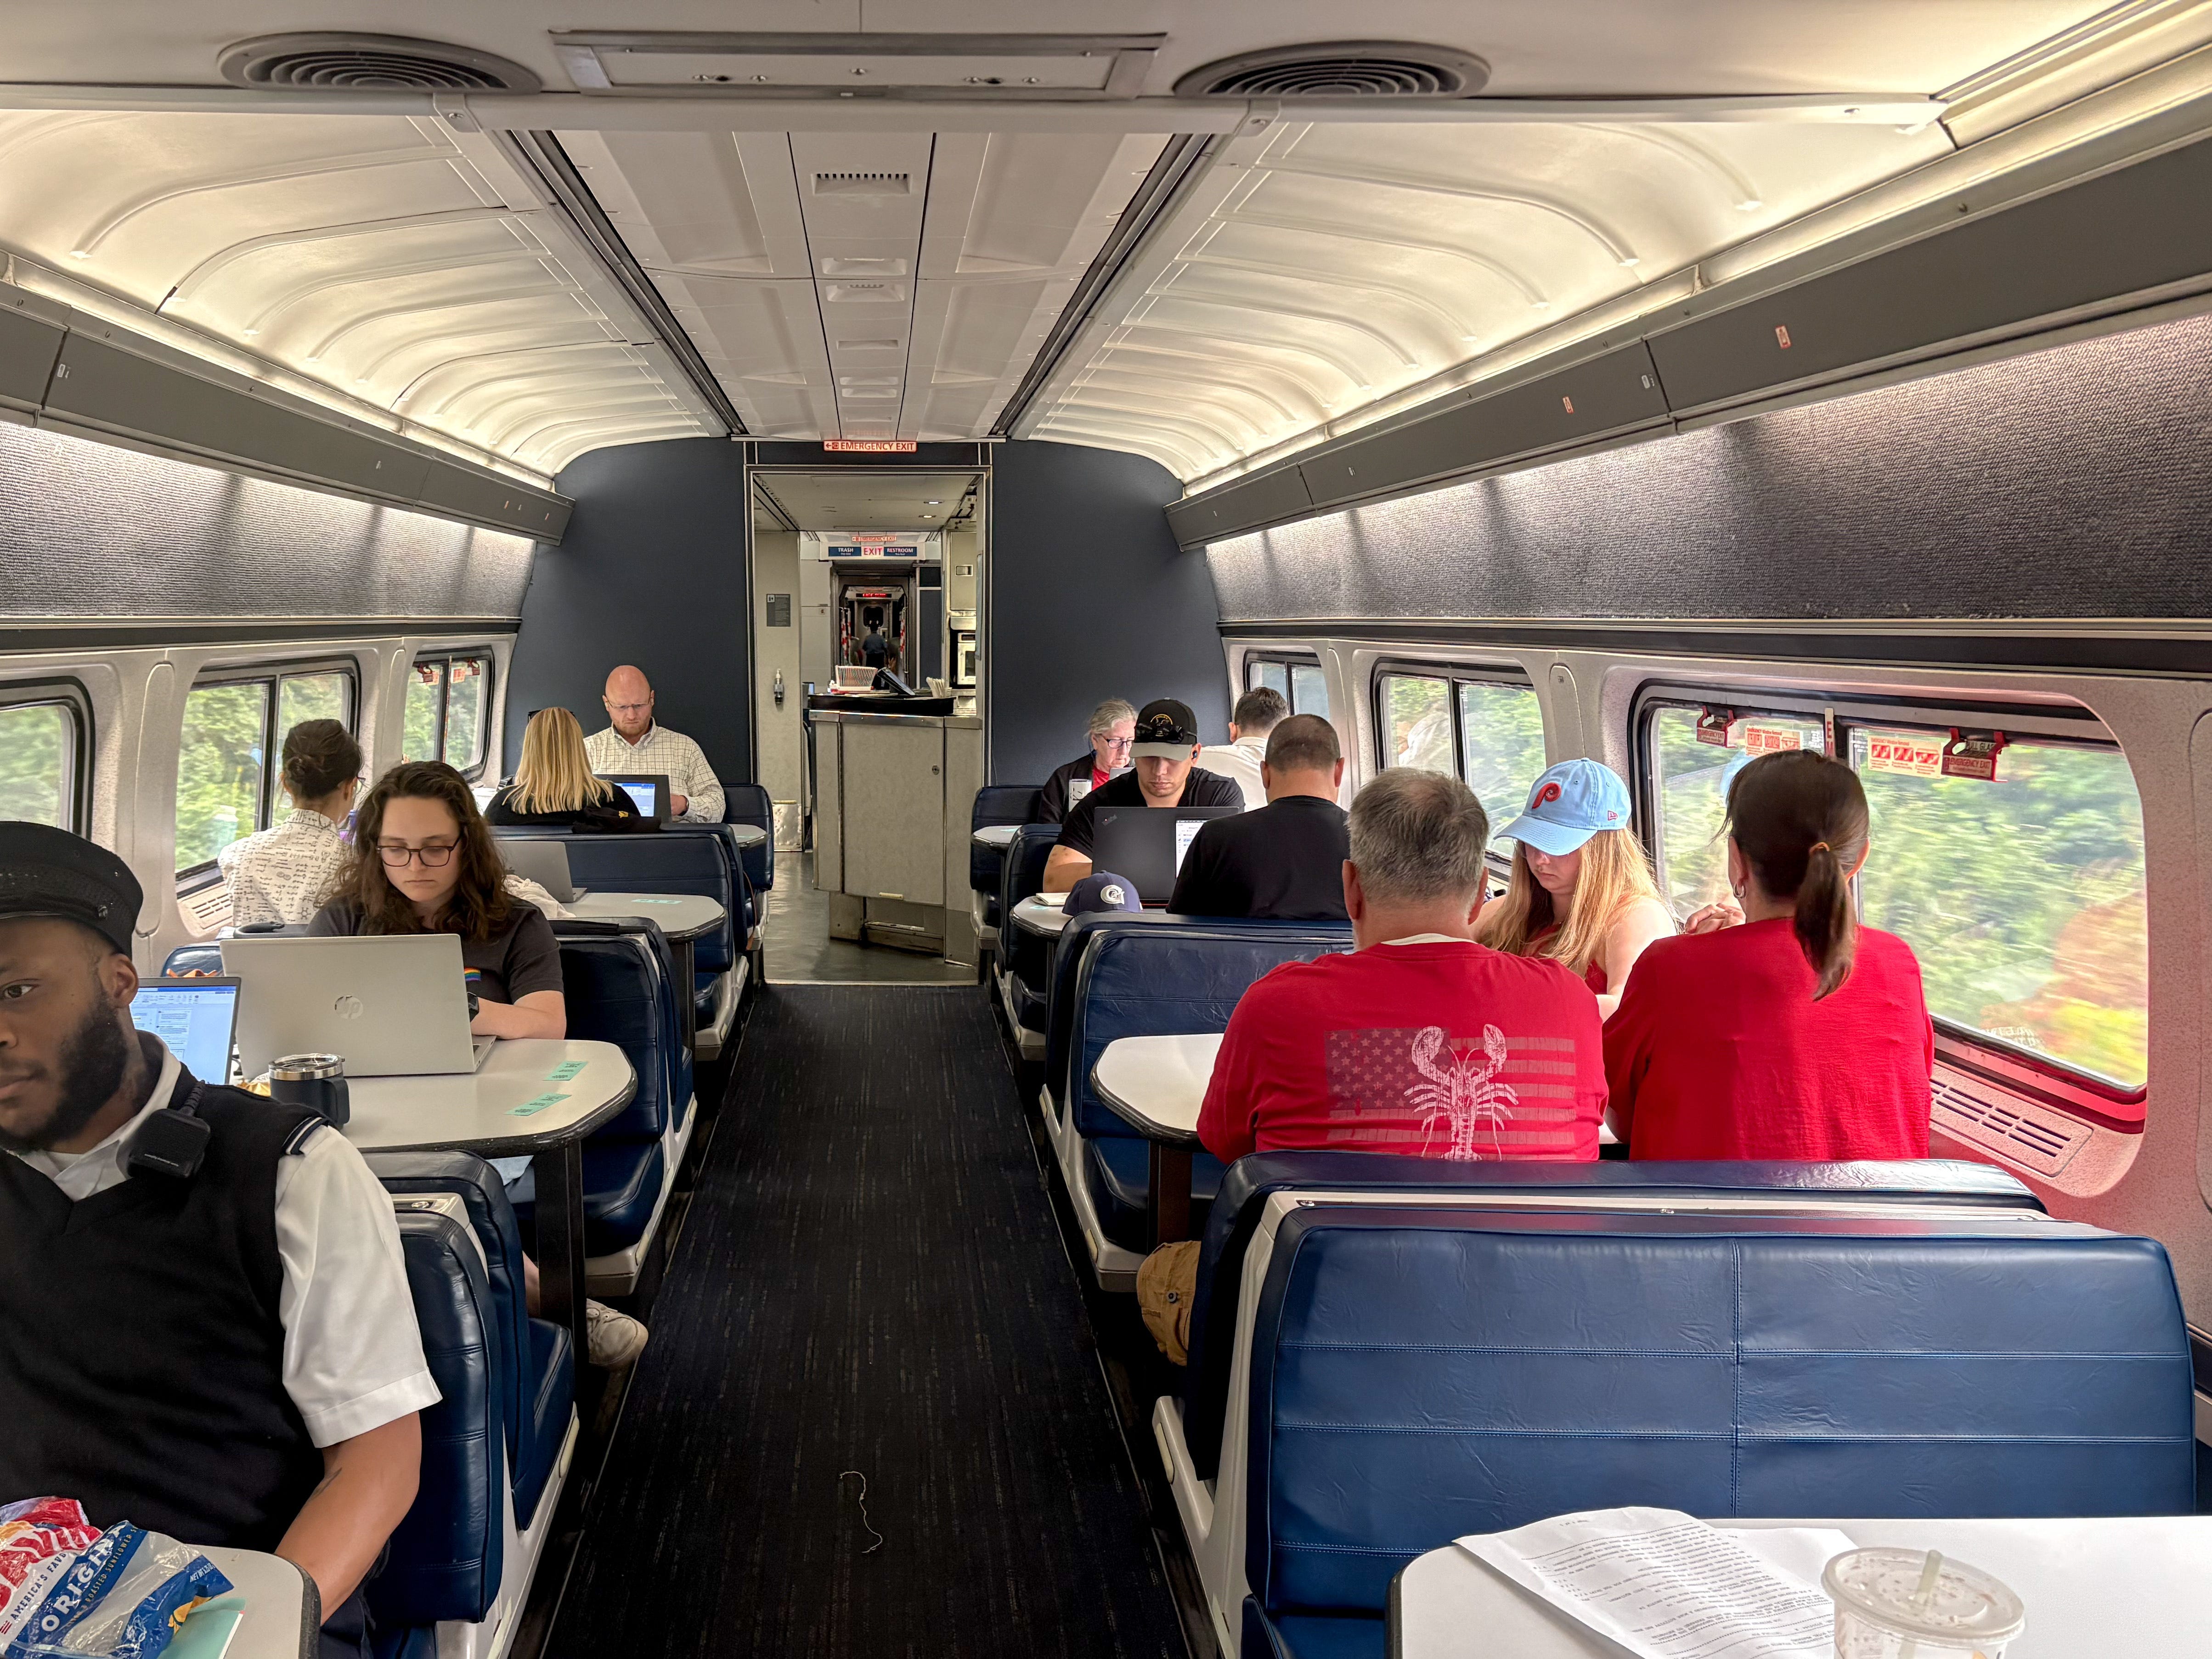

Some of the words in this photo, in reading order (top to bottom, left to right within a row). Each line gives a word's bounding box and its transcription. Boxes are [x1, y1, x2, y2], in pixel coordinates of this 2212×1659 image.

[11, 1574, 48, 1620] AMERICA'S
[85, 1574, 107, 1603] ROASTED
[105, 1534, 132, 1573] SUNFLOWER
